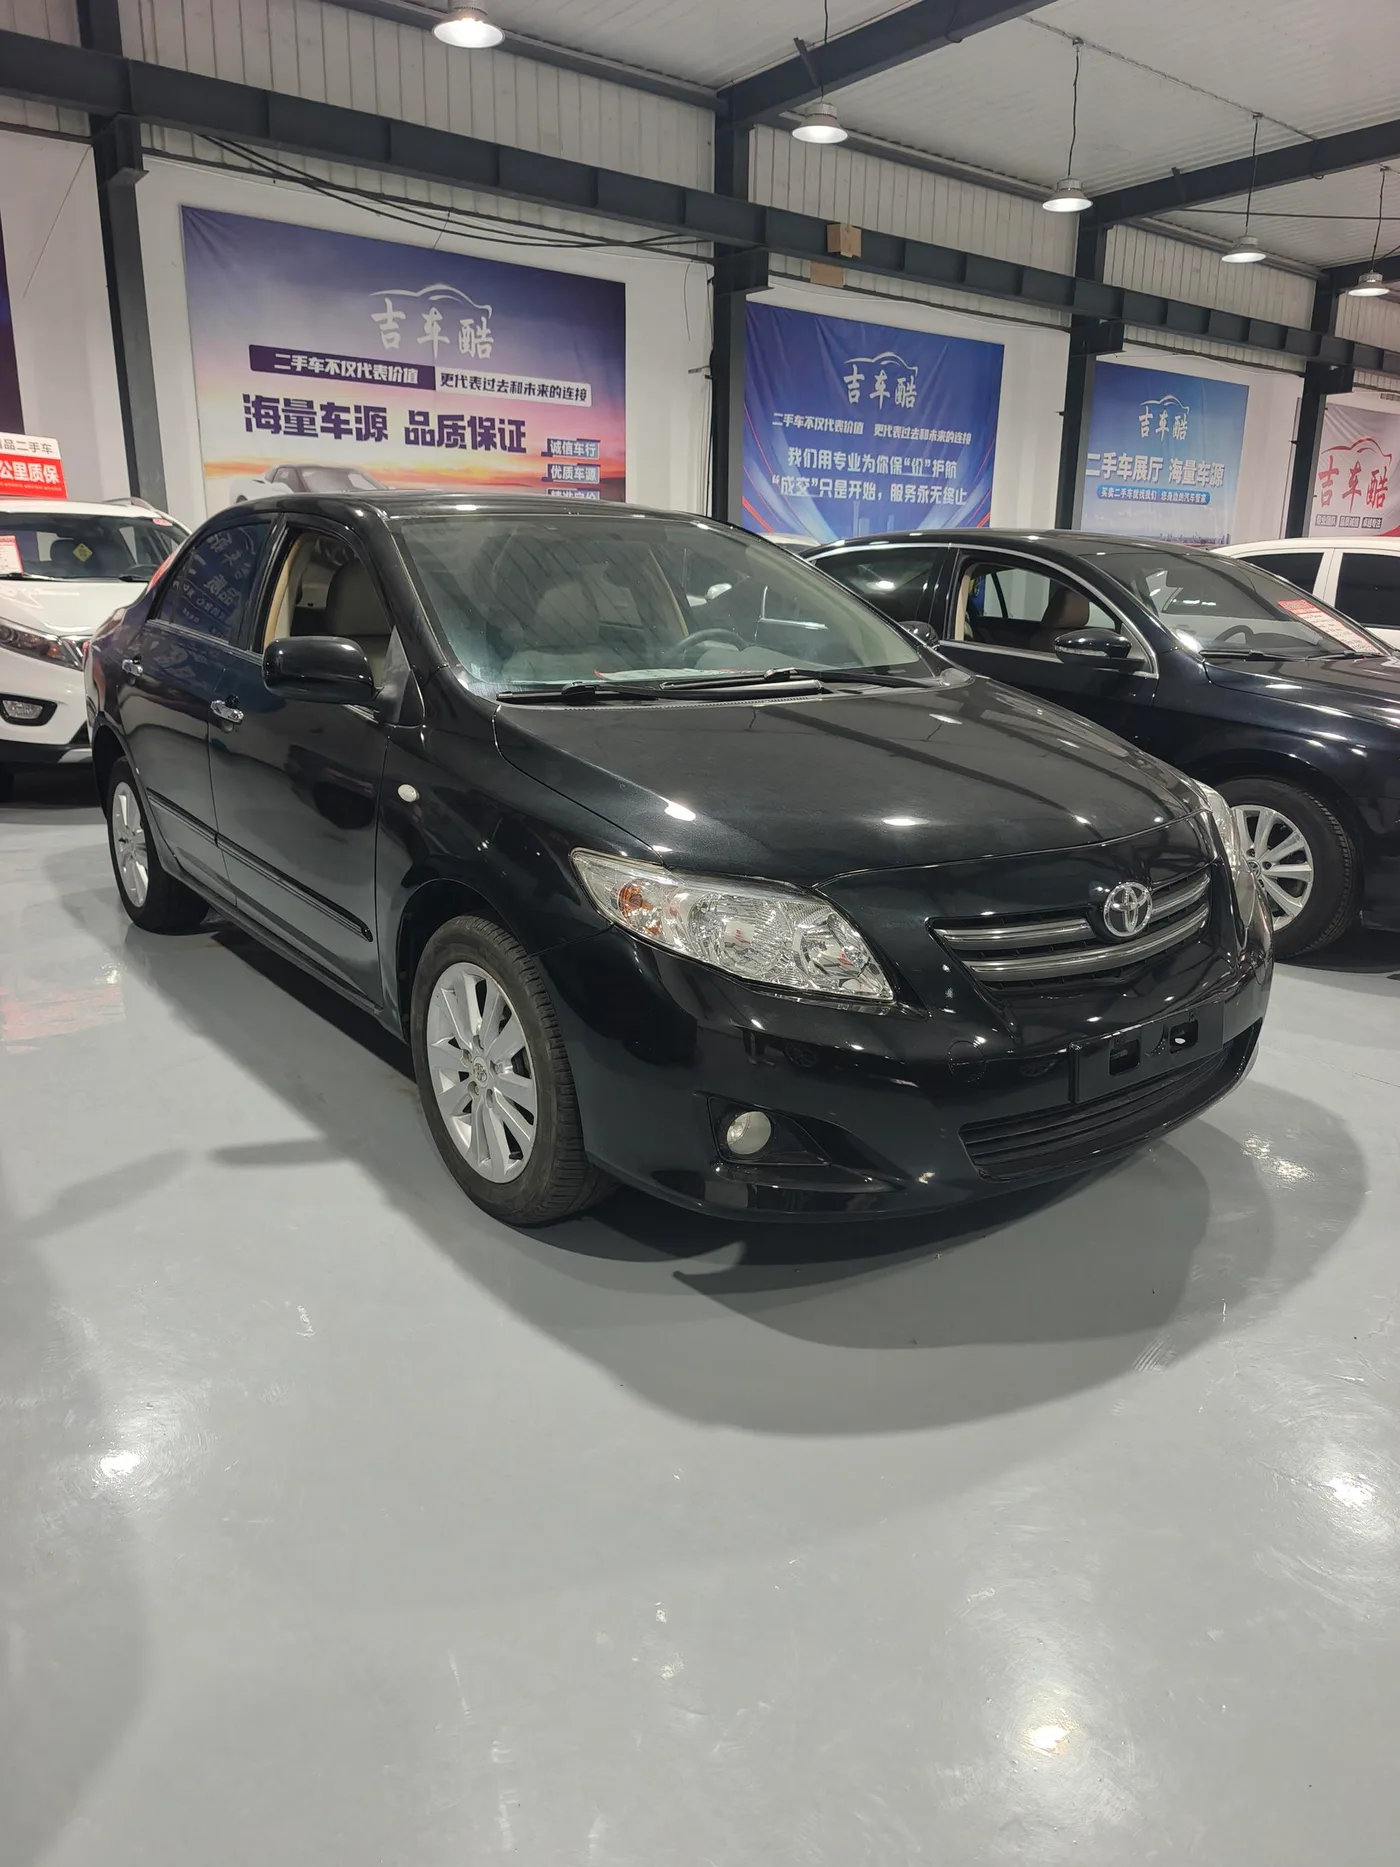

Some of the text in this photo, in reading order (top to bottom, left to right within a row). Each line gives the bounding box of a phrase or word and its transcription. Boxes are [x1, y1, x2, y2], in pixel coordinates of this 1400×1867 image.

[371, 297, 494, 359] 吉车酷
[274, 353, 588, 402] 二手车不仅代表价值 更代表过去和未来的连接
[844, 365, 917, 409] 吉车酷
[242, 394, 527, 453] 海量车源 品质保证
[772, 412, 972, 445] 二手车不仅代表价值 更代表过去和未来的连接
[1139, 406, 1188, 441] 吉车酷
[0, 438, 53, 454] 品二手车
[550, 440, 596, 457] 诚信车行
[0, 460, 60, 485] 公里质保
[551, 465, 597, 481] 优质车源
[1086, 452, 1225, 488] 二手车展厅 海量车源
[1318, 455, 1388, 513] 吉车酷
